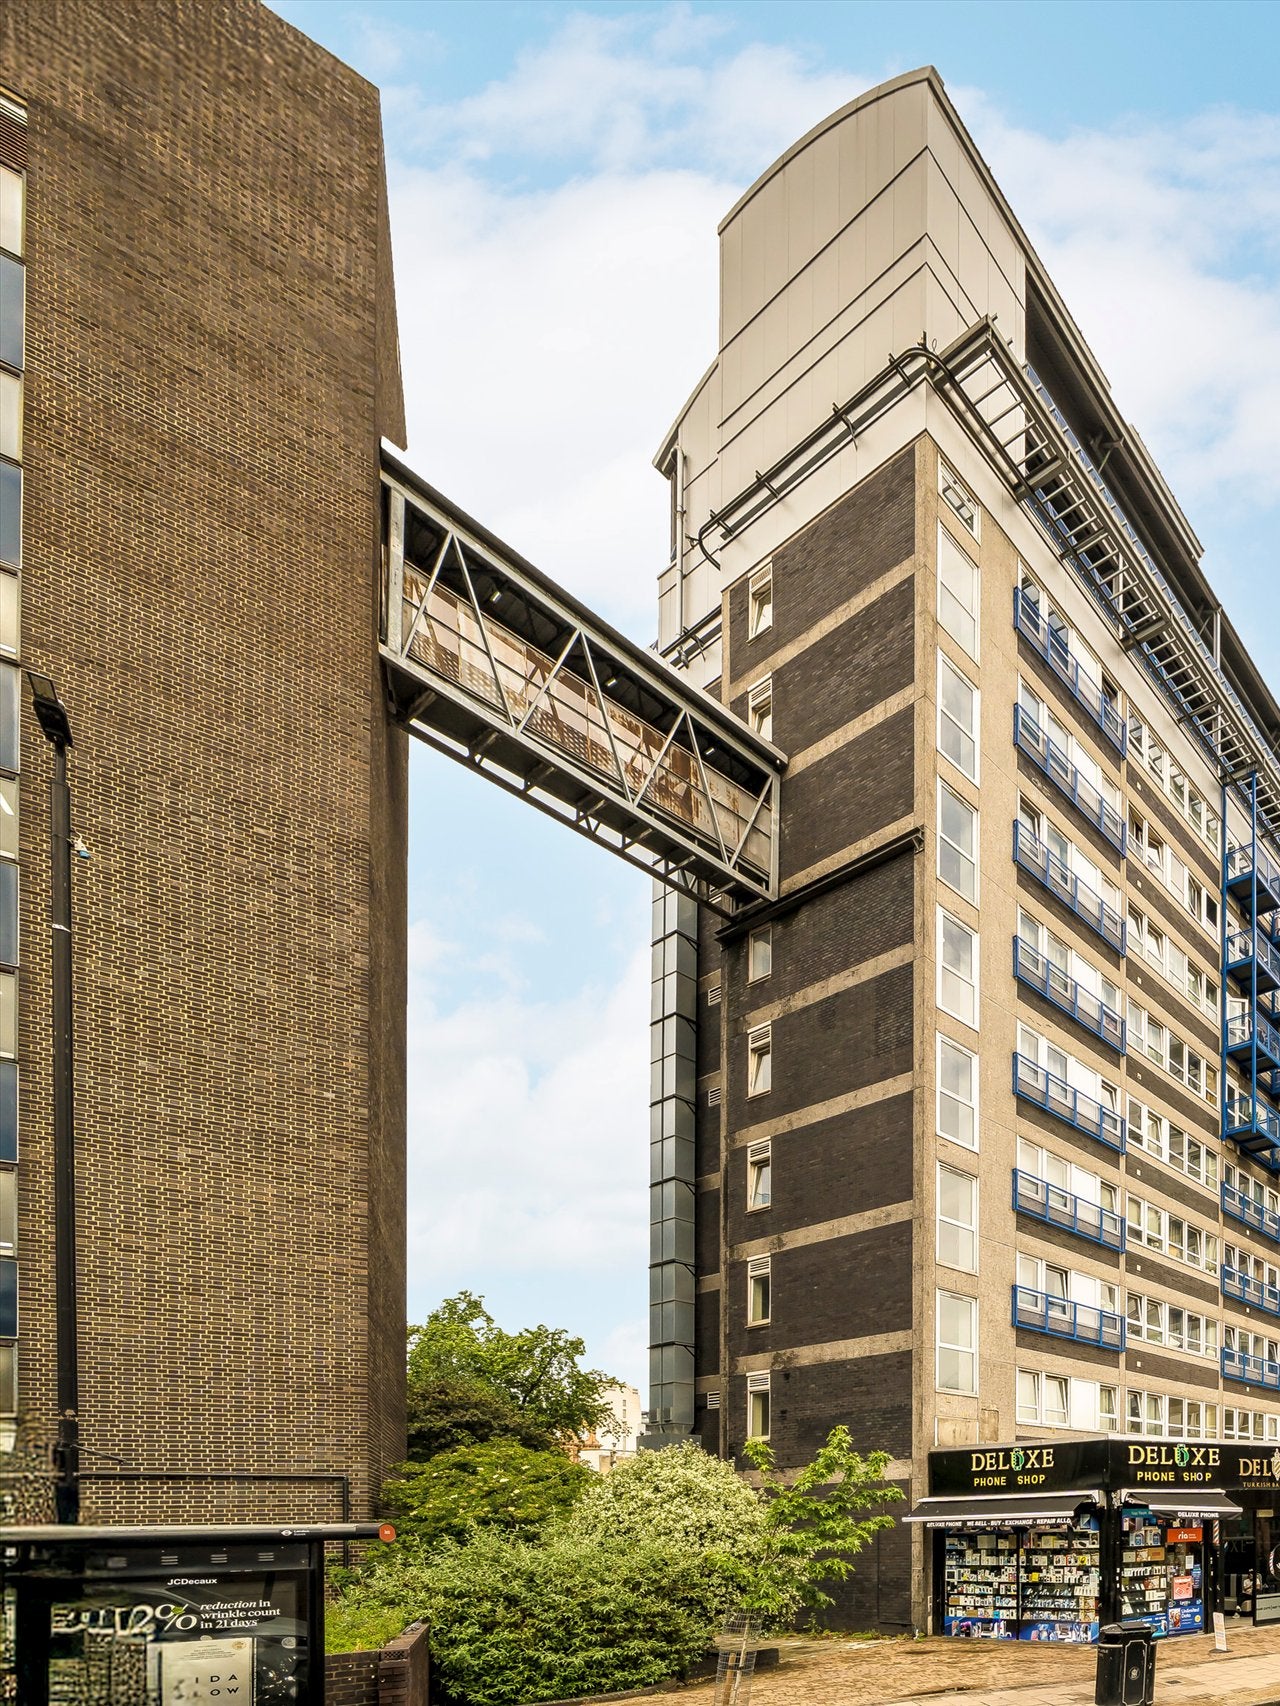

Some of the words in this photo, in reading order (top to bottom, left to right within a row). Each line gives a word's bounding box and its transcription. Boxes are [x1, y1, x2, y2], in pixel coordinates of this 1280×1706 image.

[971, 1448, 1055, 1471] DELUXE
[1128, 1444, 1220, 1467] DELUXE
[973, 1476, 1007, 1487] PHONE
[1017, 1474, 1046, 1485] SHOP
[1137, 1472, 1175, 1482] PHONE
[1183, 1472, 1212, 1482] SHOP
[167, 1578, 217, 1586] JCDecaux
[200, 1601, 257, 1611] reduction
[258, 1599, 271, 1608] in
[200, 1609, 247, 1619] wrinkle
[247, 1608, 281, 1617] count
[200, 1620, 213, 1629] in
[215, 1619, 228, 1629] 21
